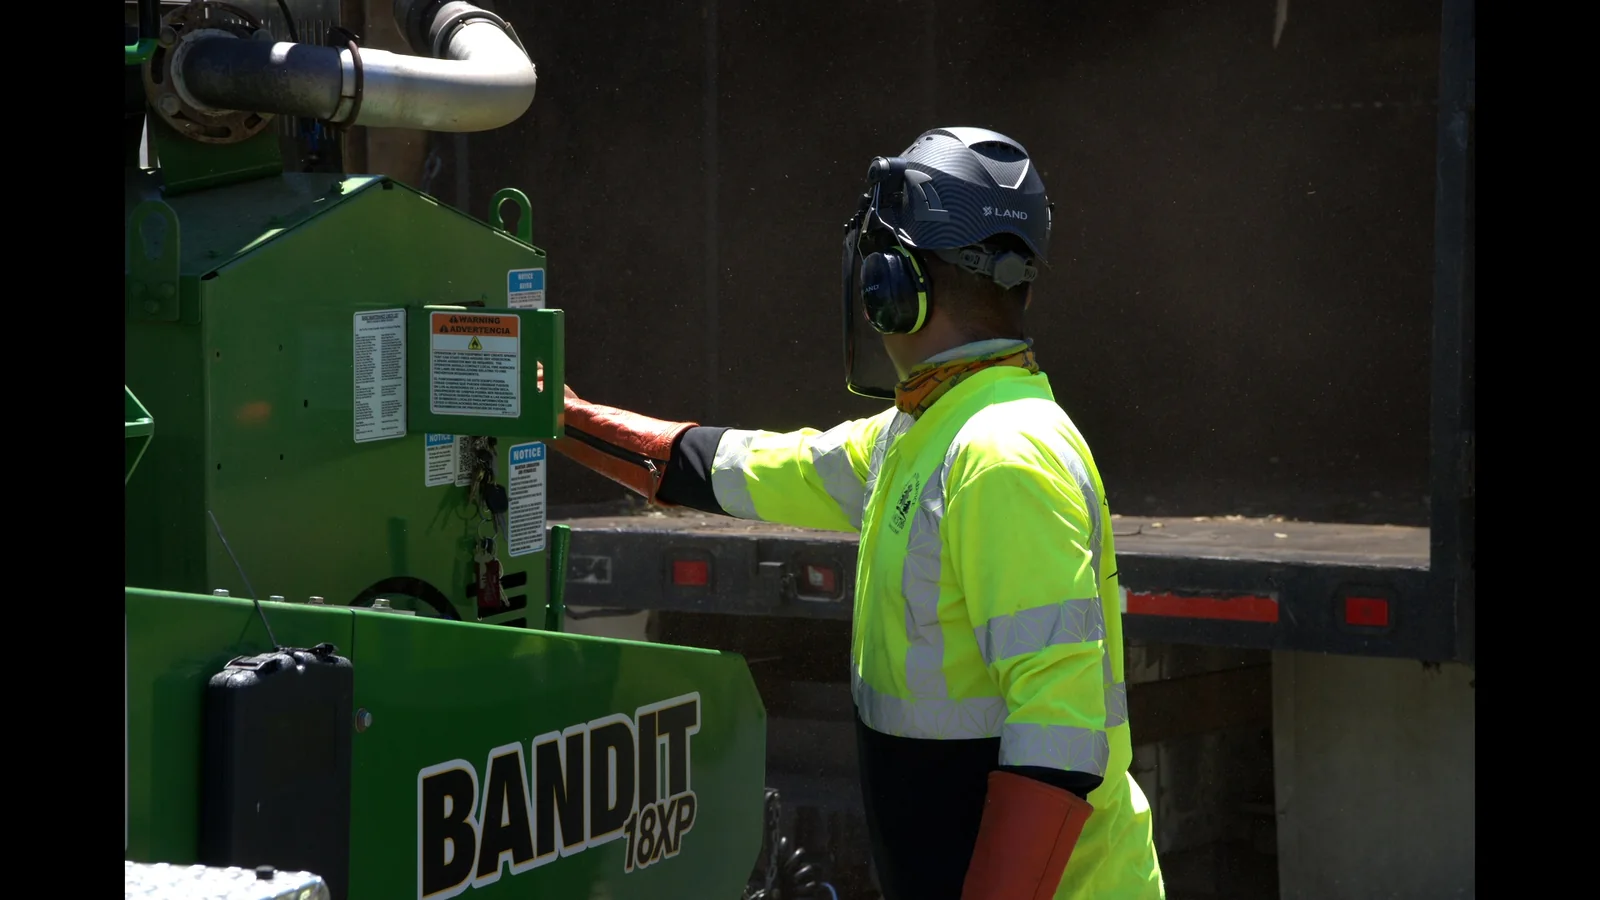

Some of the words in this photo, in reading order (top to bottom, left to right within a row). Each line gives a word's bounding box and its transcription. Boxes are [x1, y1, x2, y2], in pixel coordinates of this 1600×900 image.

[995, 207, 1028, 220] LAND
[460, 316, 500, 324] WARNING
[450, 326, 510, 334] ADVERTENCIA
[513, 447, 541, 460] NOTICE
[419, 695, 699, 899] BANDIT
[624, 793, 697, 872] 18XP
